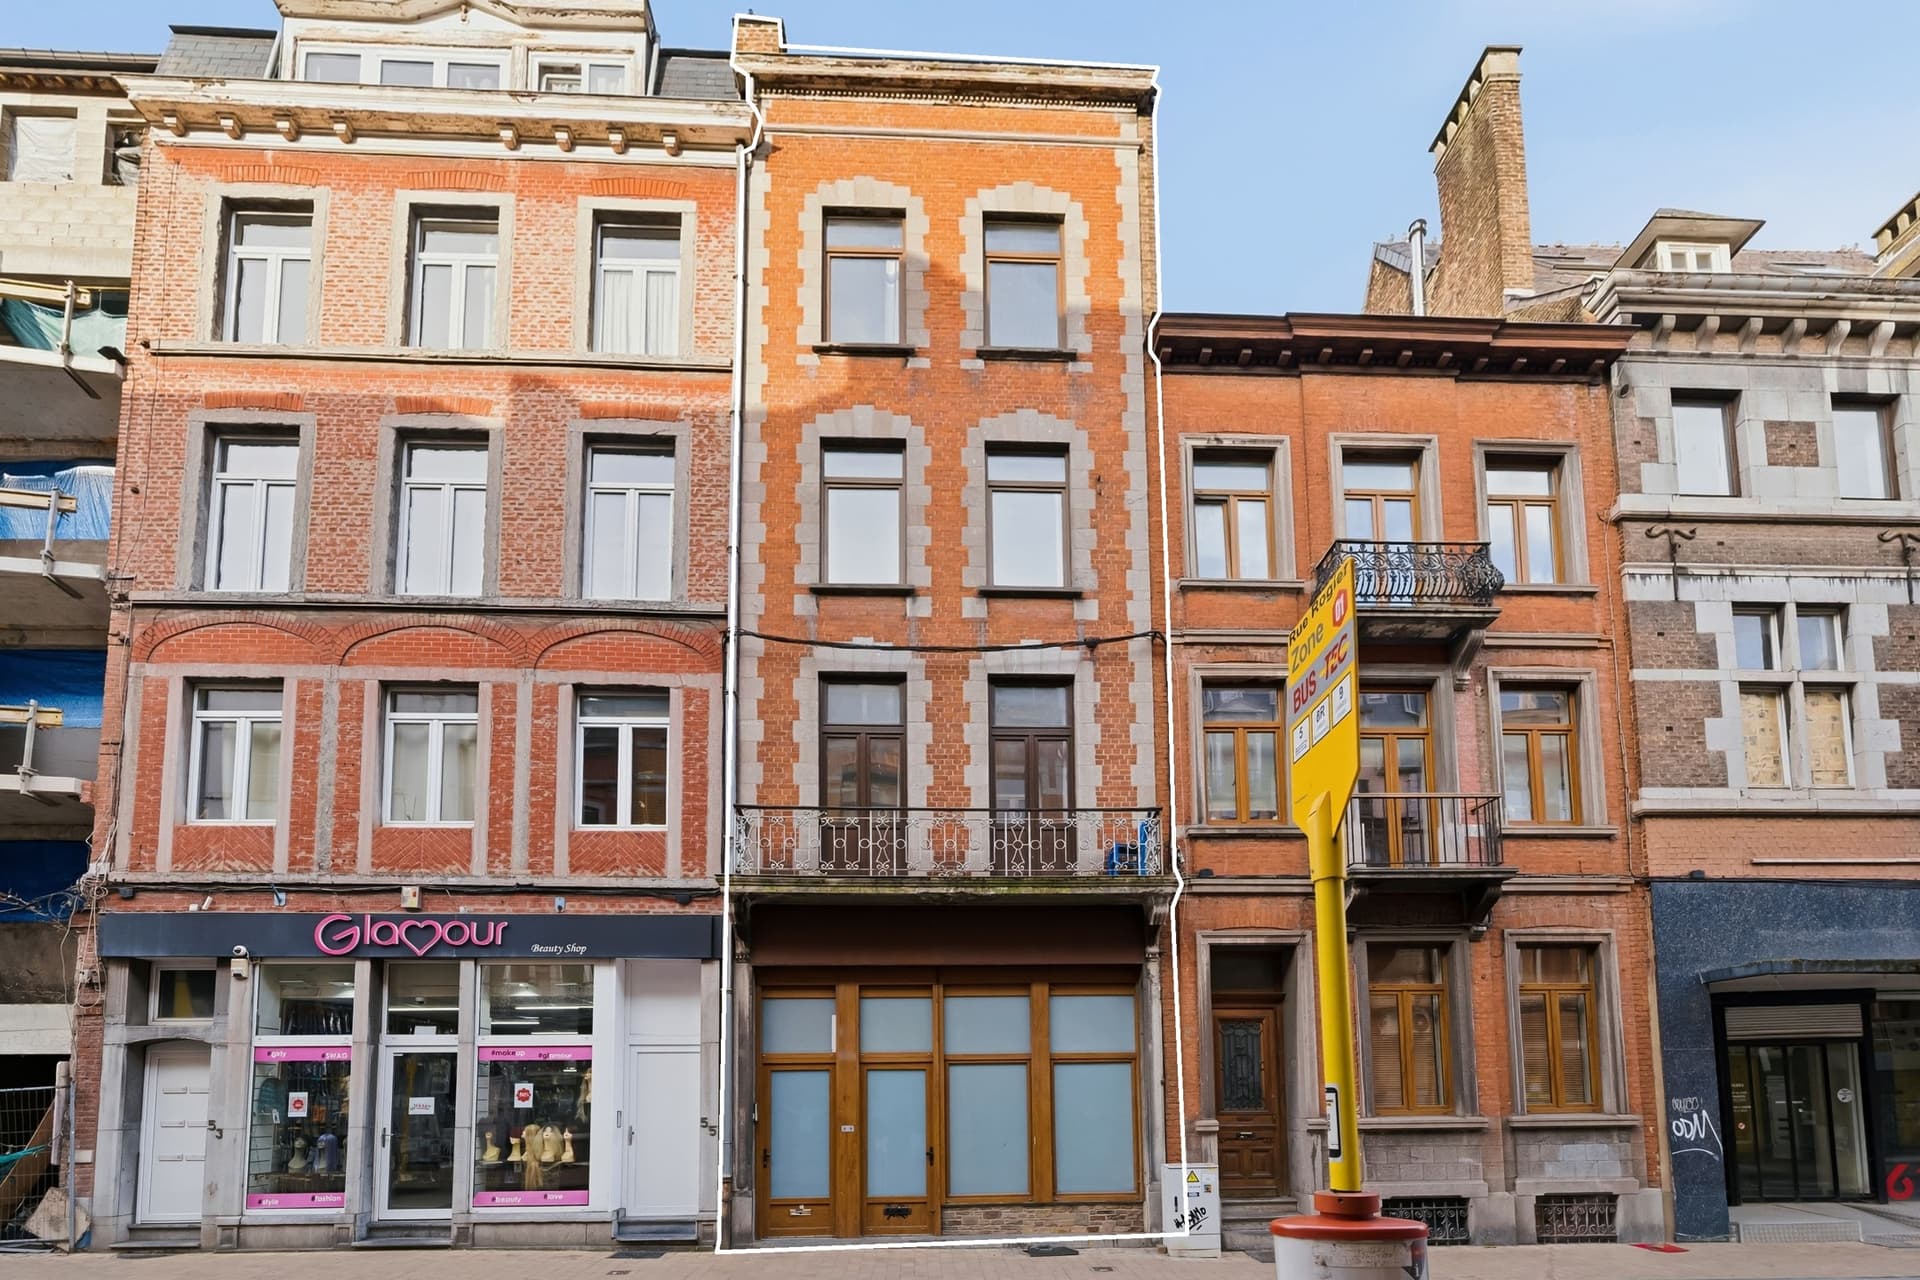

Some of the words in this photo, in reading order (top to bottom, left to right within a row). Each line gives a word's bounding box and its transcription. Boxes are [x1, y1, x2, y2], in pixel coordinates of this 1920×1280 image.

[1289, 617, 1308, 647] Rue
[1311, 563, 1348, 618] Rogier
[1291, 622, 1324, 673] Zone
[1293, 670, 1317, 714] BUS
[1325, 633, 1348, 680] TEC
[1338, 686, 1344, 699] 9
[531, 943, 563, 955] Beauty
[564, 943, 588, 955] Shop
